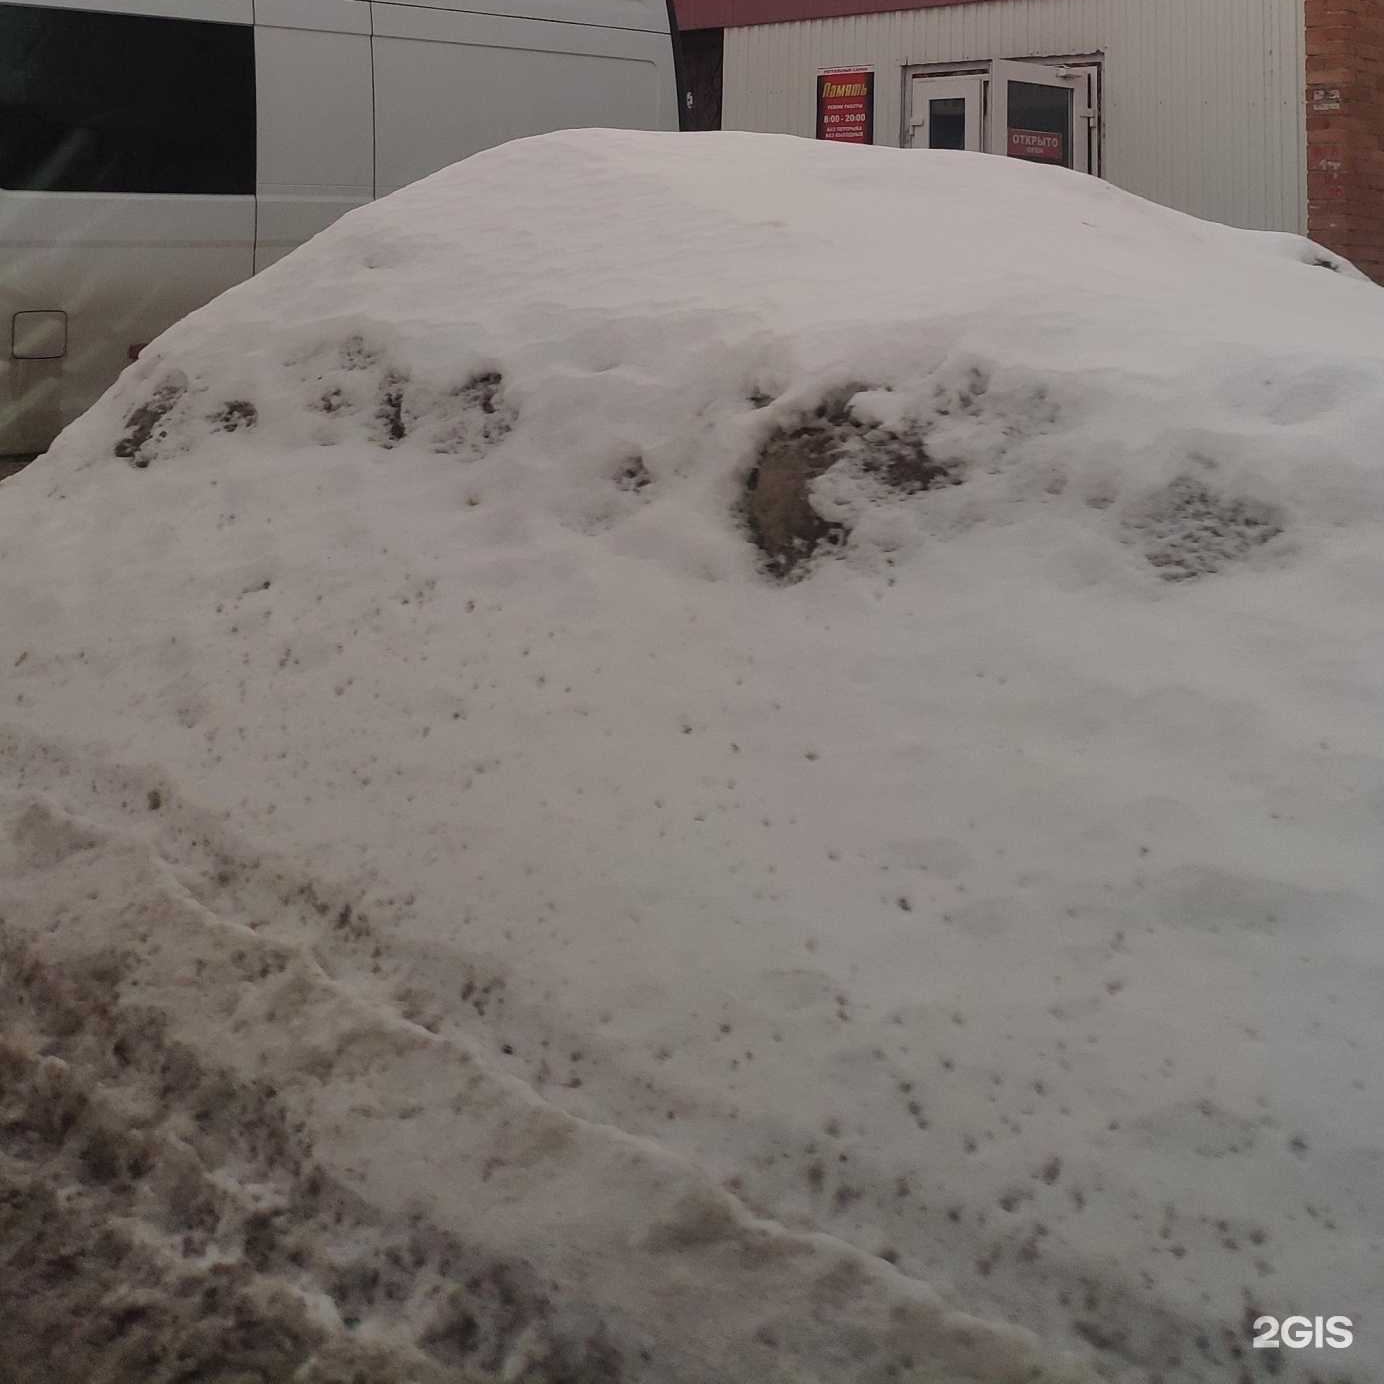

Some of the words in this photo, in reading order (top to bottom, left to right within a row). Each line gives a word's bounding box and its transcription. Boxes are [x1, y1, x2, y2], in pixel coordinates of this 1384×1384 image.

[822, 82, 868, 98] Память
[824, 115, 840, 123] 8:00
[845, 113, 866, 122] 20:00
[1012, 134, 1058, 147] ОТКРЫТО
